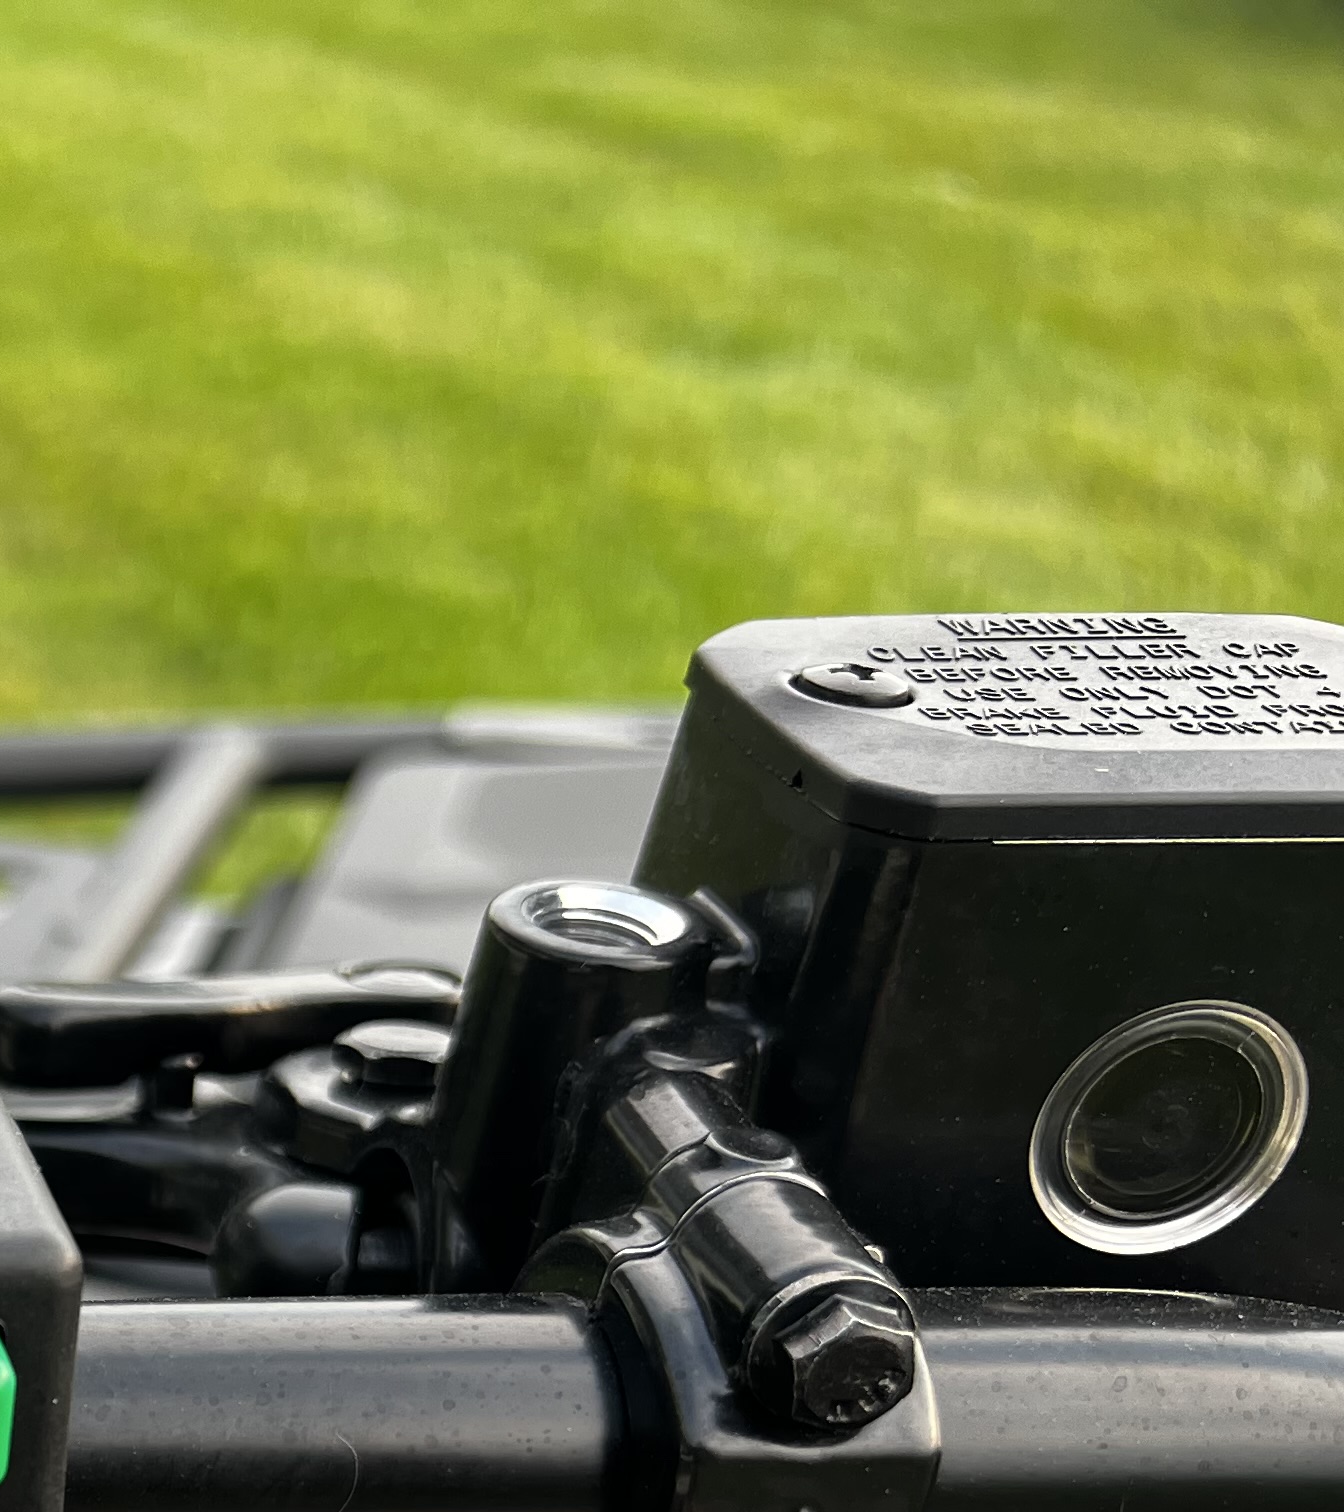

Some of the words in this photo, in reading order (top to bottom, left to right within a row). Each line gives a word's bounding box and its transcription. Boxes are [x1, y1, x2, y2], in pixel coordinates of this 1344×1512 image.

[937, 618, 1178, 636] WARNING
[867, 646, 1007, 661] CLEAN
[1029, 645, 1201, 660] FILLER
[1222, 643, 1300, 659] CAP
[904, 666, 1078, 682] BEFORE
[1099, 664, 1328, 681] REMOVING
[942, 686, 1037, 701] USE
[1059, 686, 1170, 701] ONLY
[1196, 685, 1281, 700] DOT
[917, 707, 1070, 720] BRAKE
[1091, 705, 1239, 719] FLUID
[966, 722, 1144, 736] SEALED
[1169, 721, 1344, 735] CONTAI
